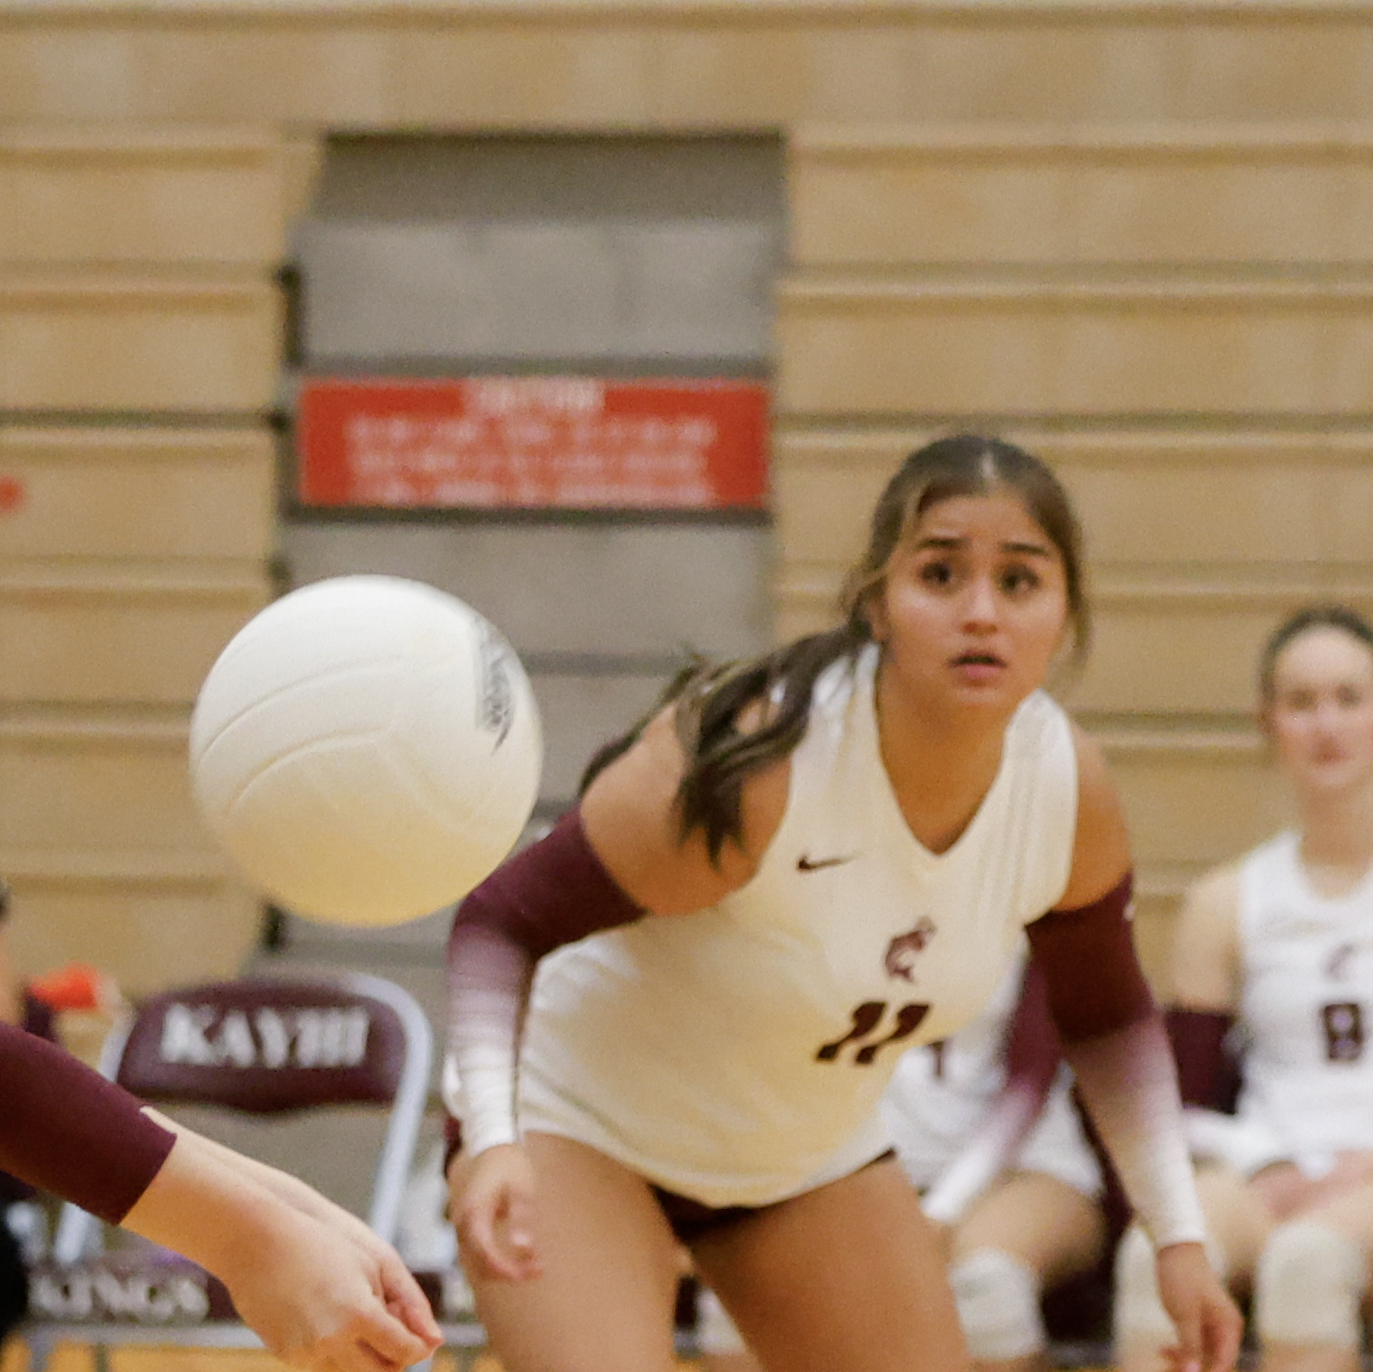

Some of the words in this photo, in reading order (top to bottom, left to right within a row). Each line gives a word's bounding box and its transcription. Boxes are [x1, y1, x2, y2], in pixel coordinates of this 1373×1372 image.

[161, 1003, 370, 1070] KAYHI
[814, 1001, 931, 1063] 11
[1320, 1001, 1363, 1062] 8
